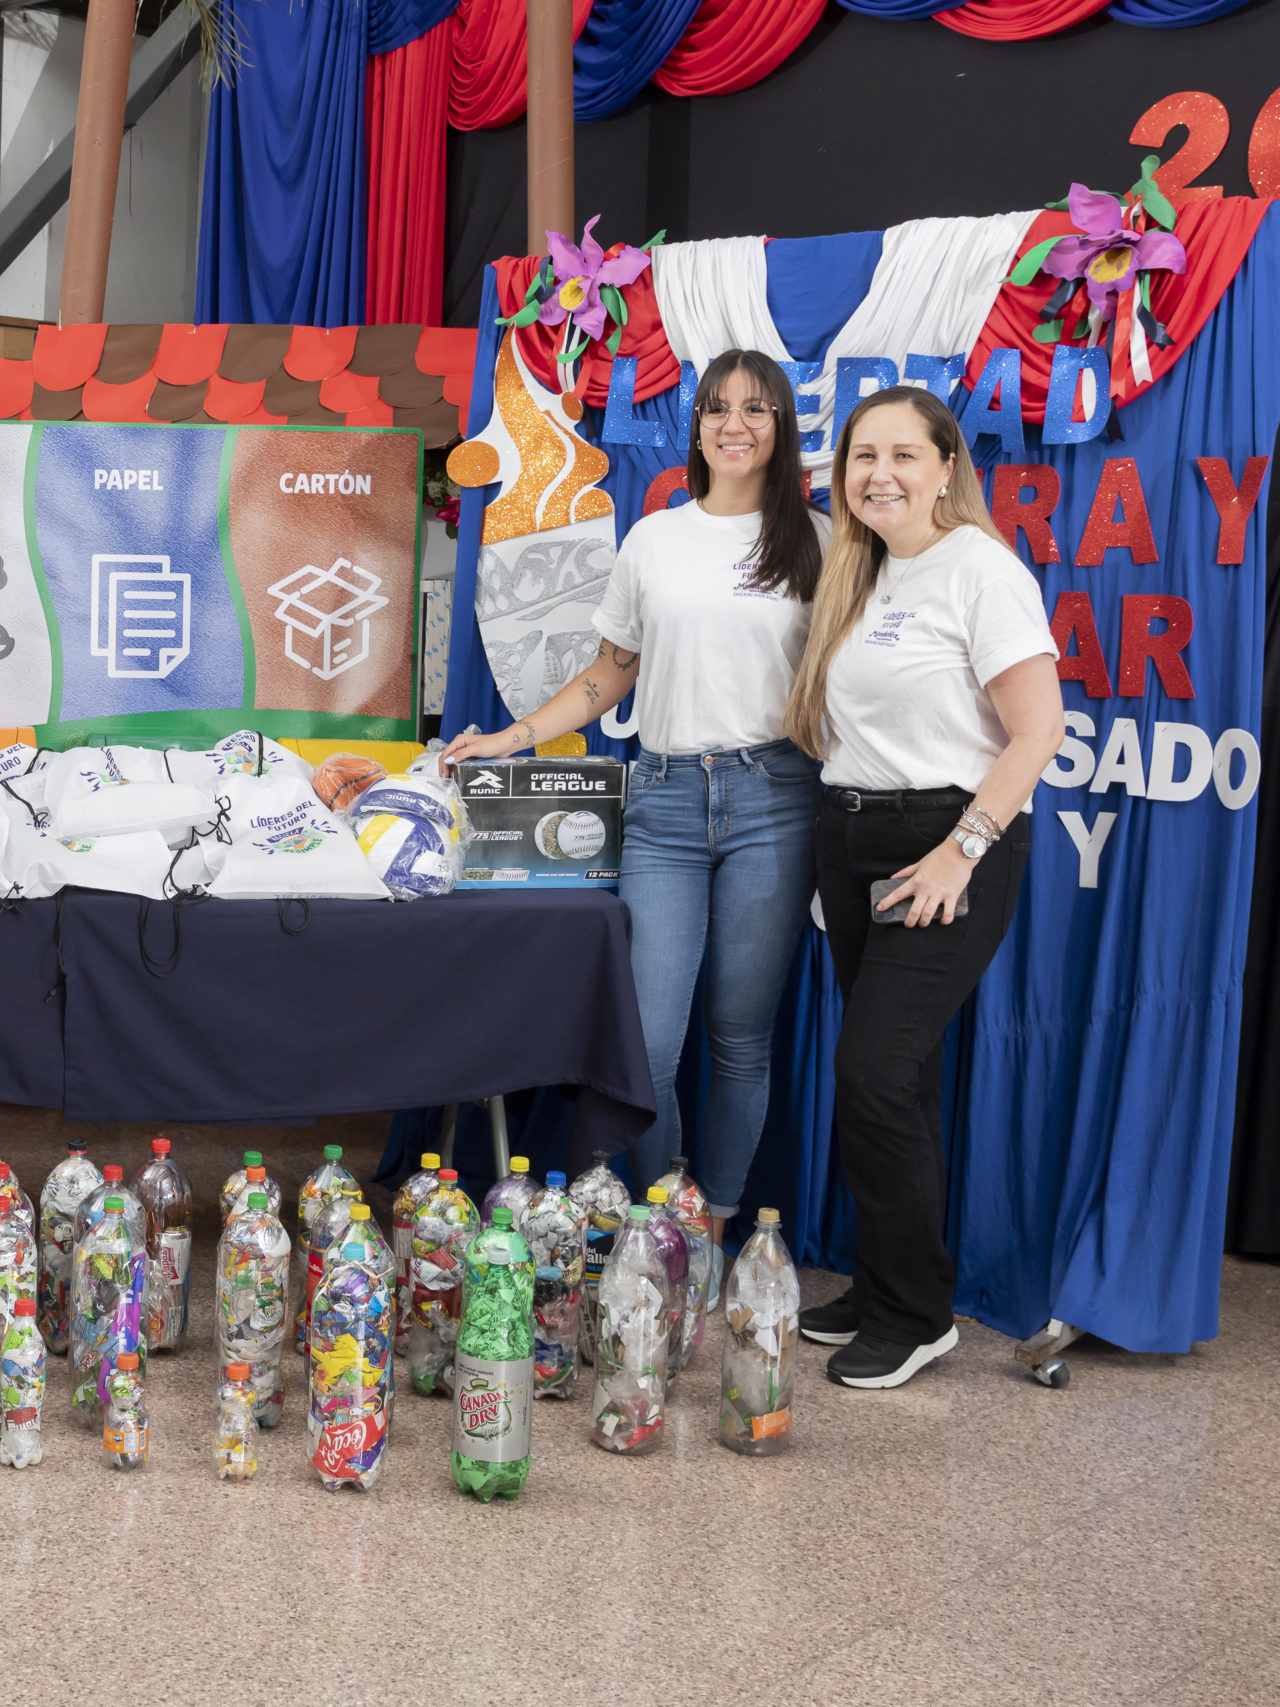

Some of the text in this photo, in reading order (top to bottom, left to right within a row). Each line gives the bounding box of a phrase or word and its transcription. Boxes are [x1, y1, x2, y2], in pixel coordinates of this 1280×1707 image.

[94, 469, 164, 491] PAPEL
[279, 469, 372, 495] CARTÓN
[1196, 455, 1270, 565] Y
[1048, 591, 1196, 699] AR
[1039, 710, 1261, 811] SADO
[530, 773, 585, 781] OFFICIAL
[530, 781, 607, 791] LEAGUE
[250, 800, 317, 829] LÍDERES DEL
[1056, 811, 1118, 889] Y
[460, 1392, 508, 1411] CANADA
[469, 1404, 498, 1429] DRY
